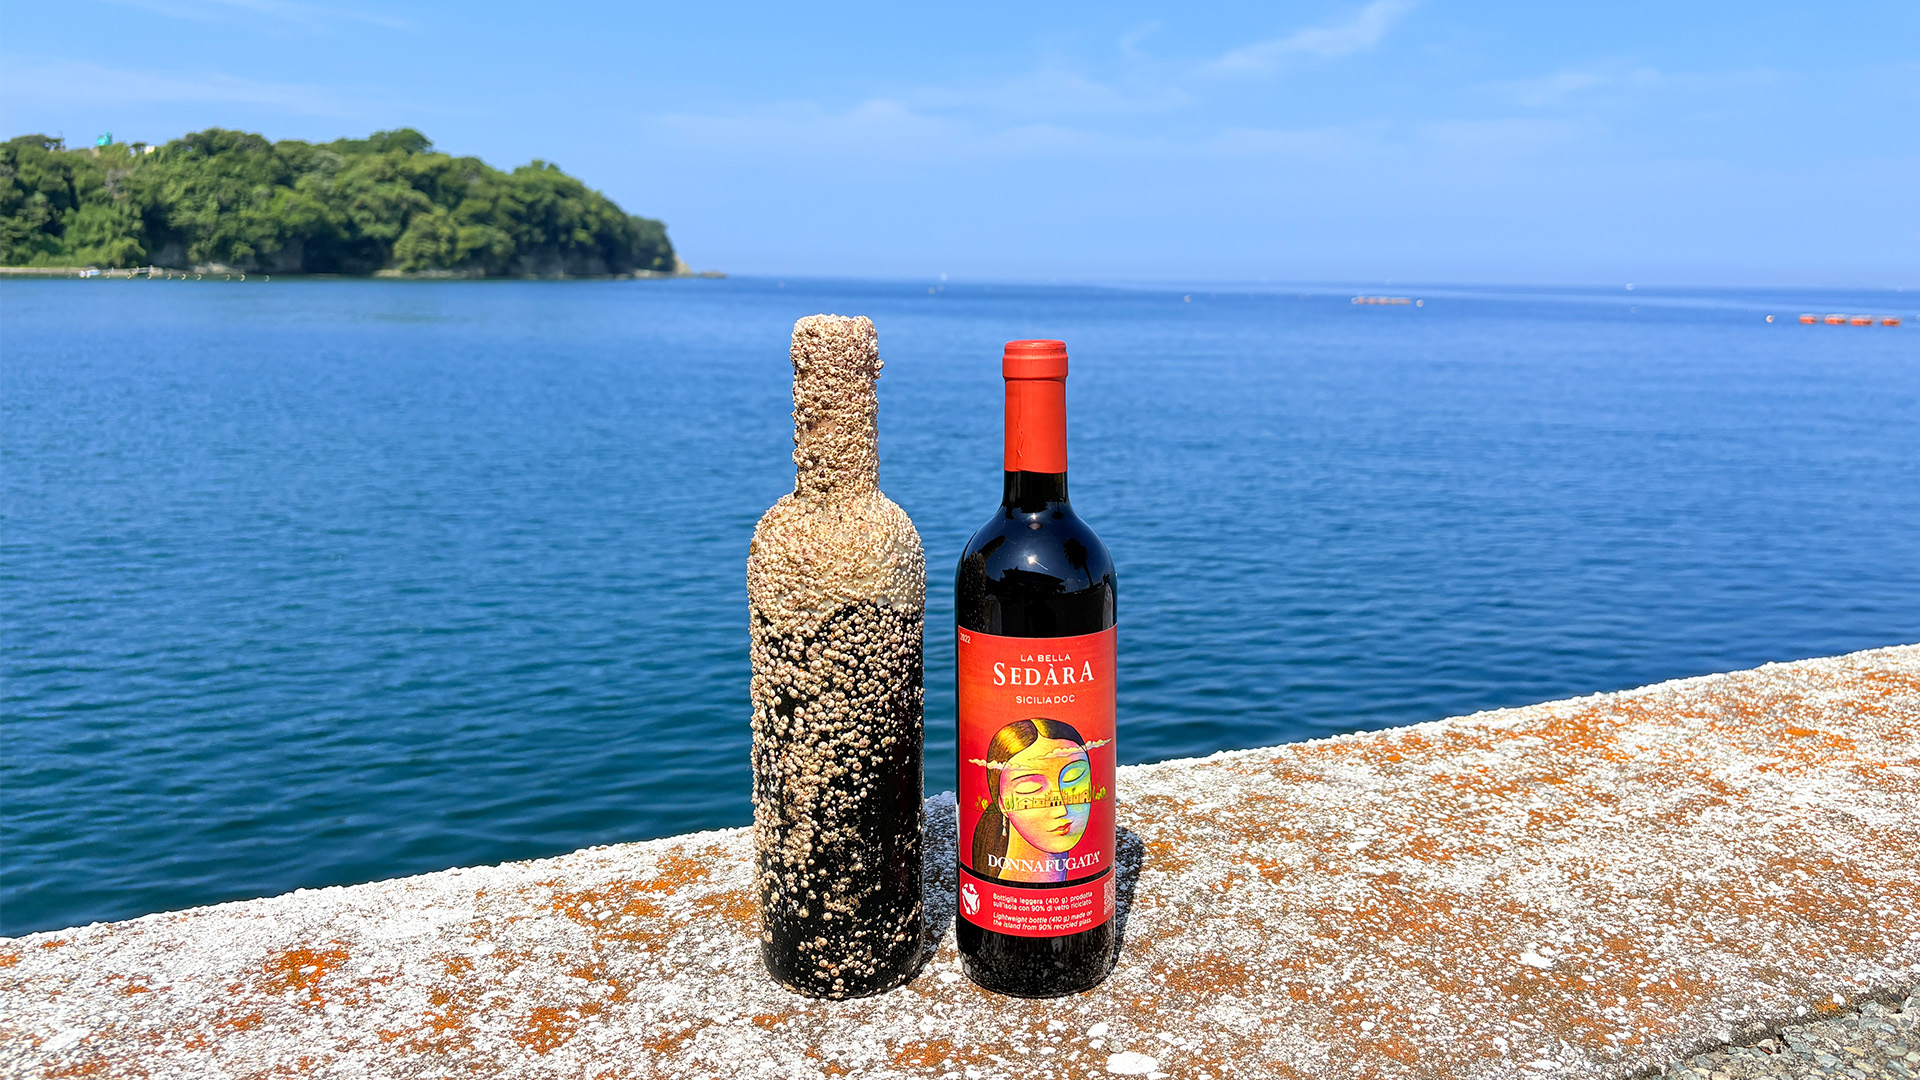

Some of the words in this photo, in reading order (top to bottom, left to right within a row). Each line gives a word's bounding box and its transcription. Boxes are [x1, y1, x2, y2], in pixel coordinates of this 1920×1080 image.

[1038, 653, 1071, 662] BELLA
[993, 660, 1094, 686] SEDÀRA
[1016, 696, 1052, 704] SICILIA
[1054, 695, 1076, 704] DOC
[993, 893, 1017, 903] Bottiglia
[1070, 892, 1093, 902] prodotta
[993, 912, 1028, 923] Lightweight
[1071, 912, 1085, 920] made
[1003, 921, 1021, 930] island
[1053, 920, 1078, 930] recycled
